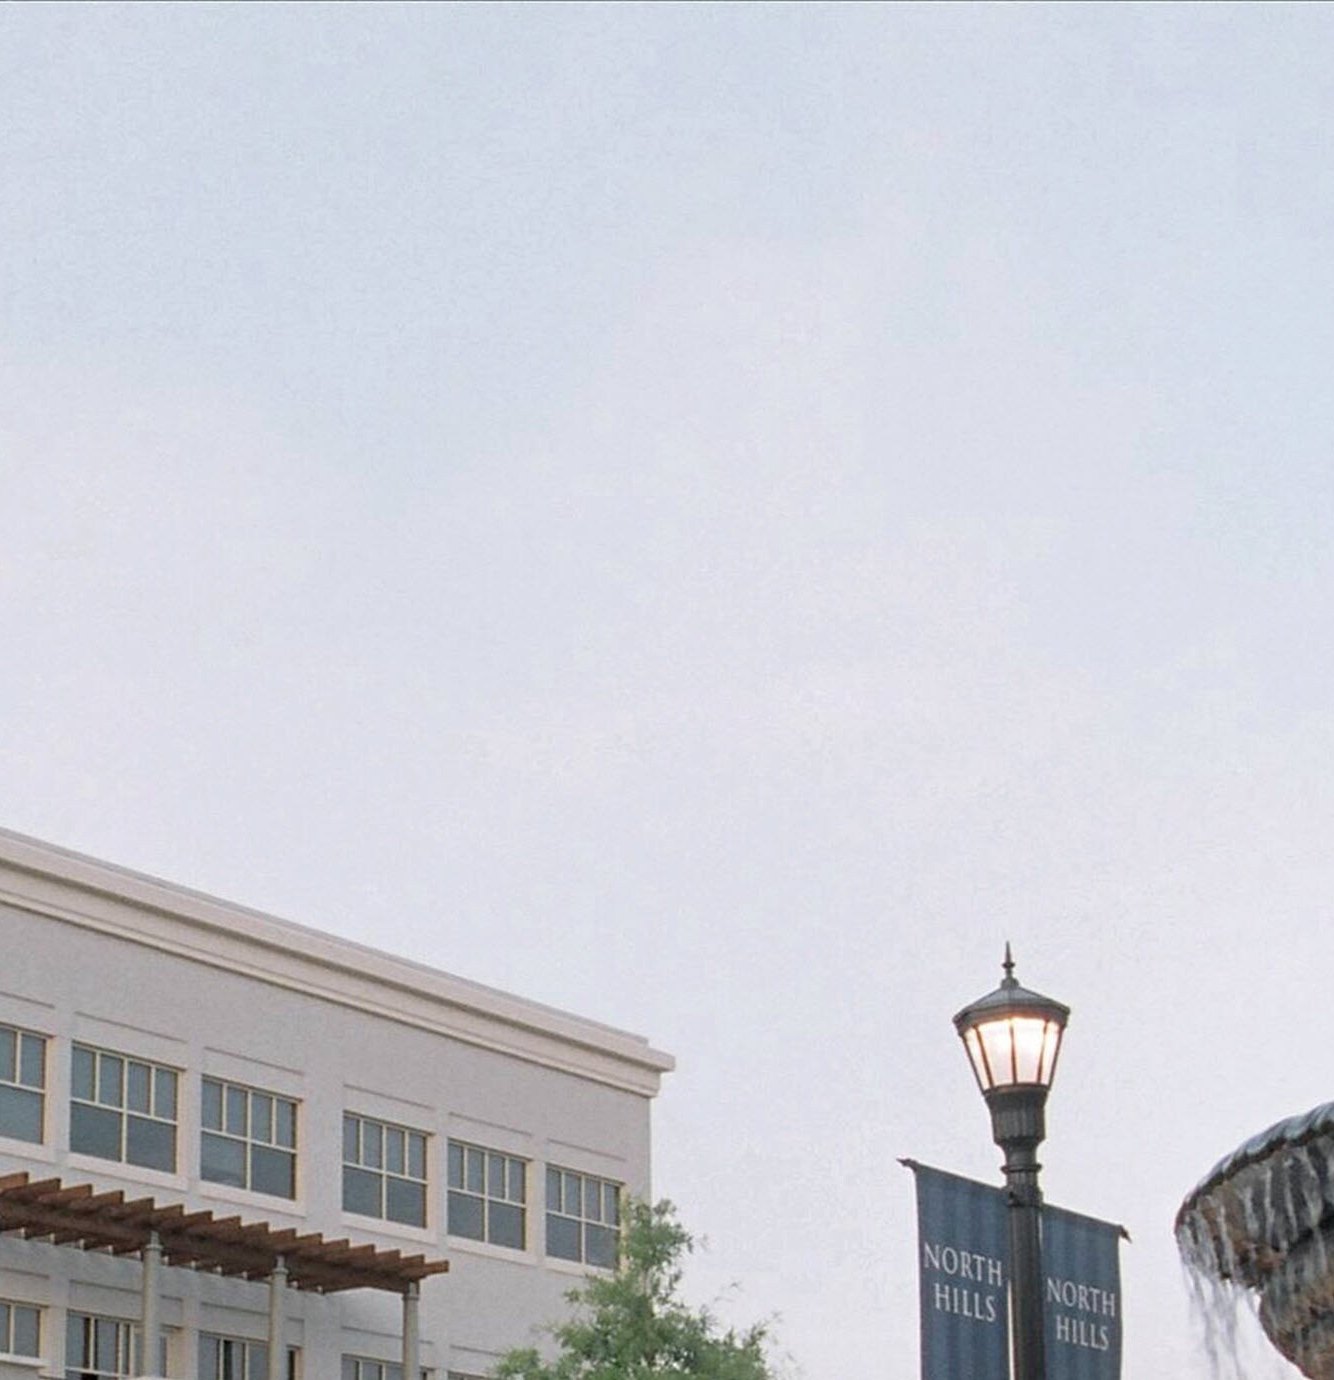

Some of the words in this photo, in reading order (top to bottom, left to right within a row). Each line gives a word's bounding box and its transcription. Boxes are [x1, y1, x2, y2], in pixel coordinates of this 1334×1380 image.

[923, 1242, 1003, 1287] NORTH
[934, 1282, 997, 1322] HILLS
[1046, 1277, 1116, 1317] NORTH
[1055, 1314, 1110, 1350] HILLS
